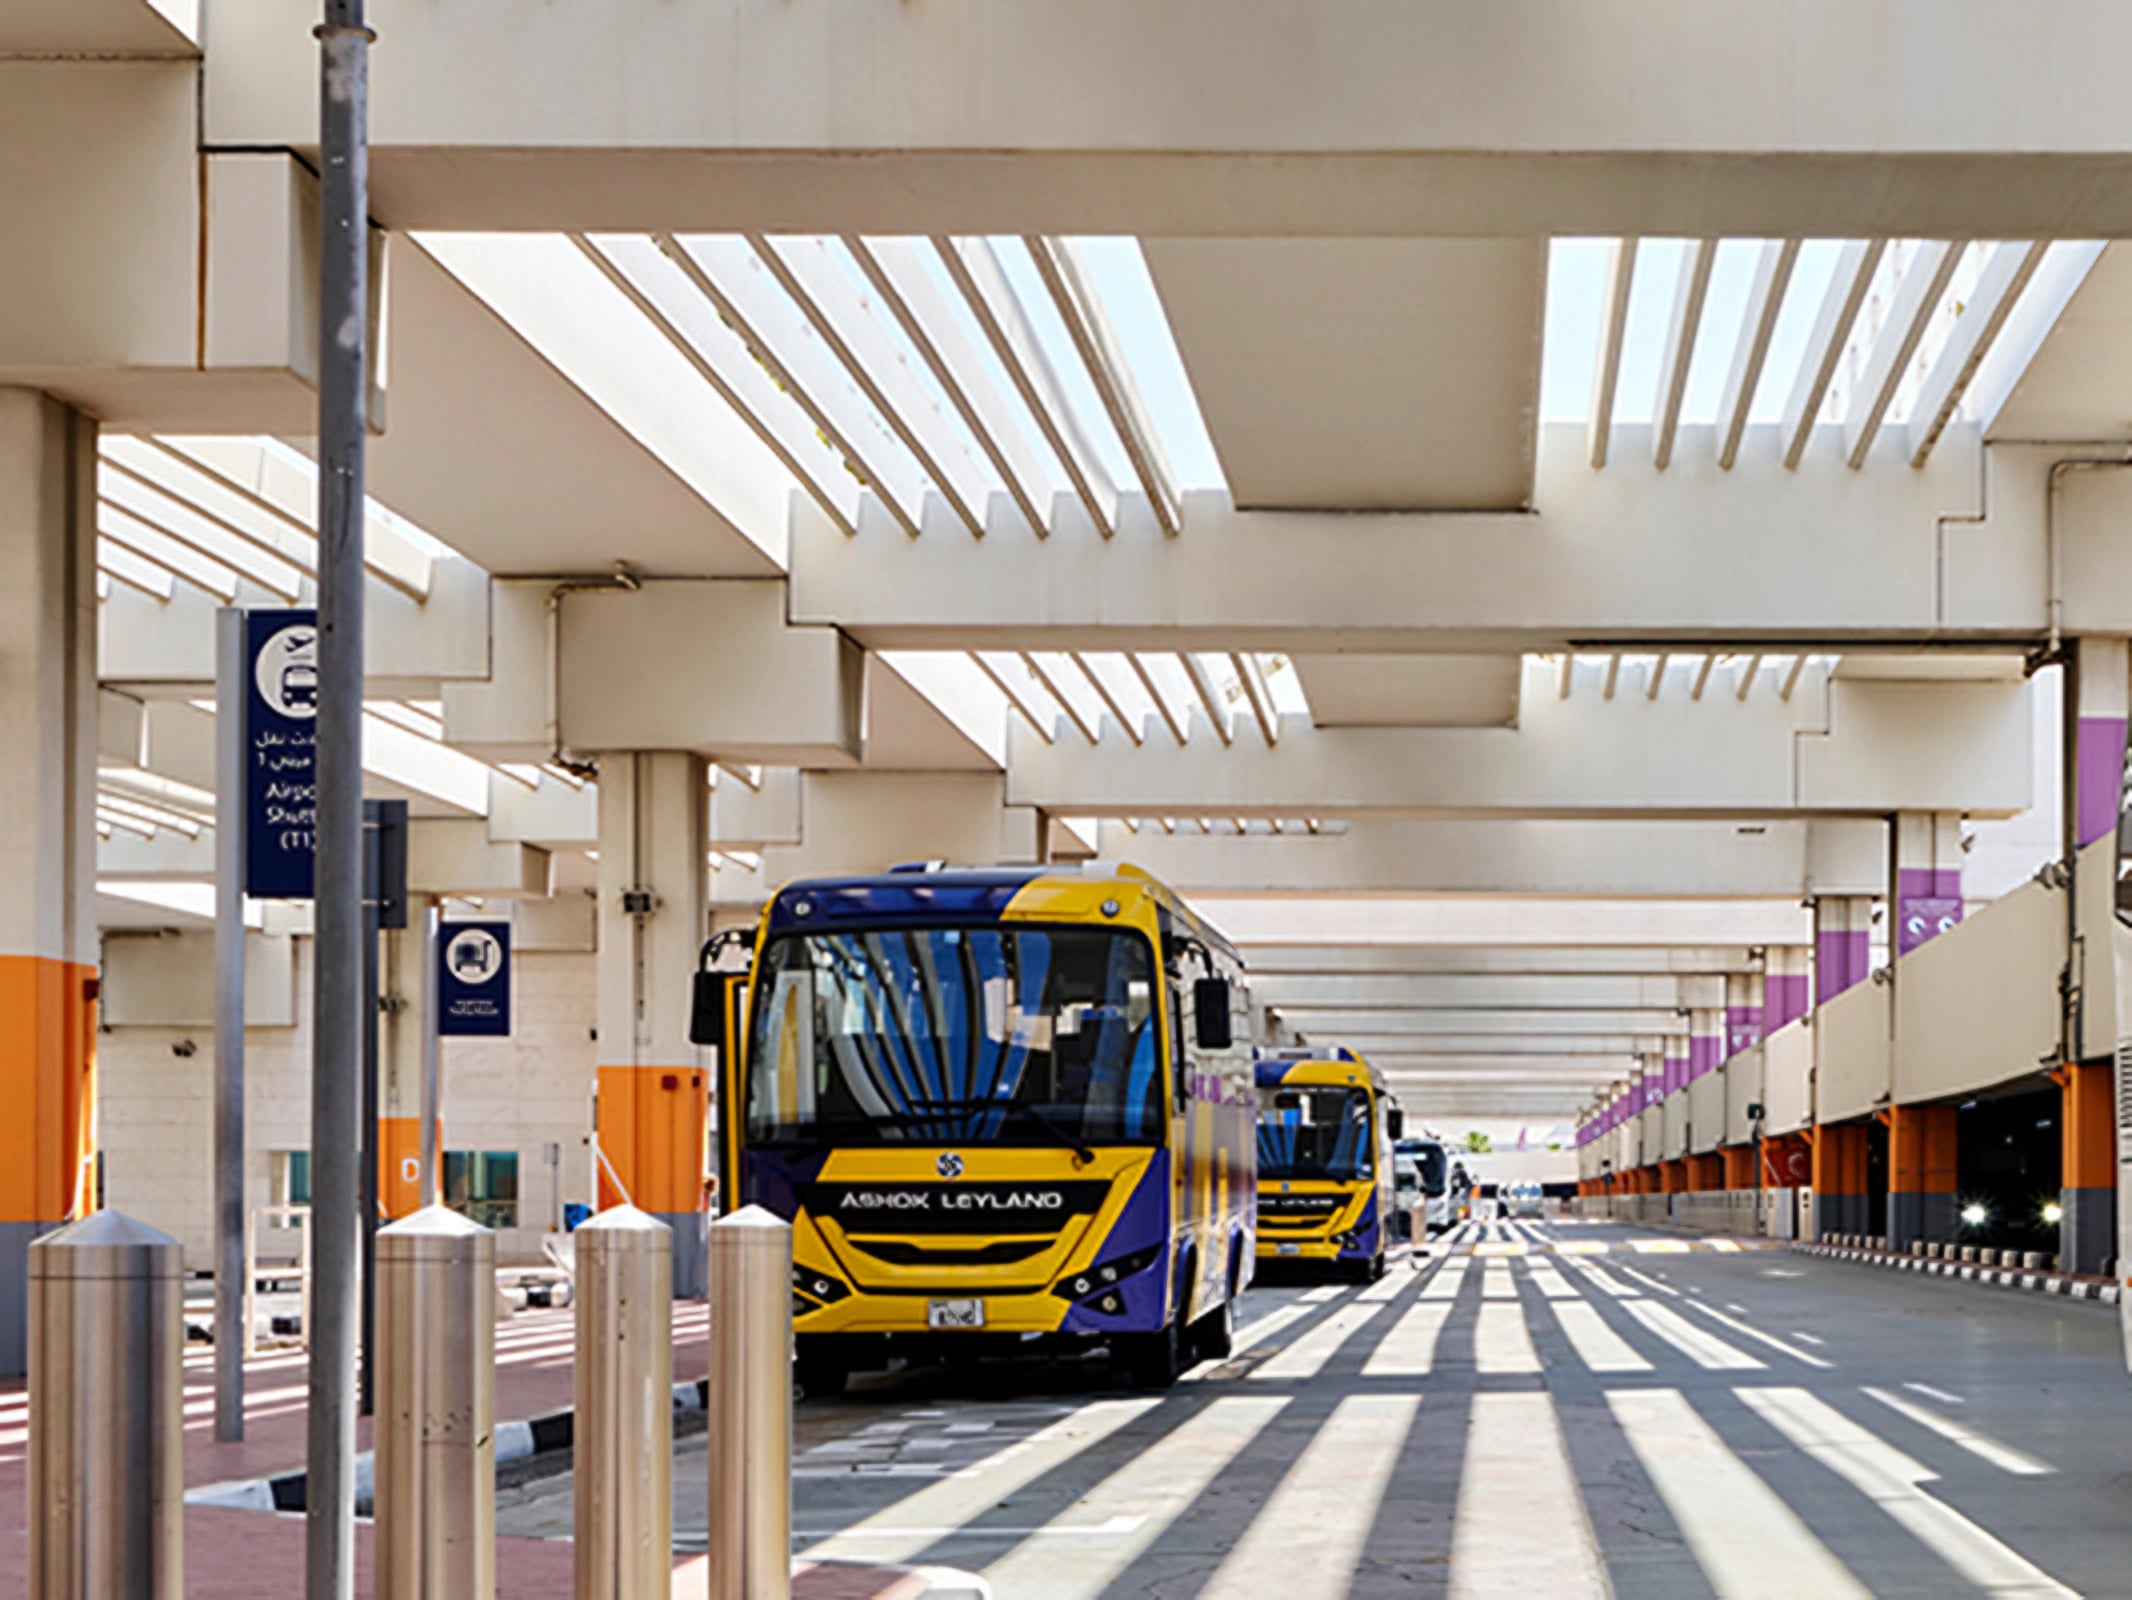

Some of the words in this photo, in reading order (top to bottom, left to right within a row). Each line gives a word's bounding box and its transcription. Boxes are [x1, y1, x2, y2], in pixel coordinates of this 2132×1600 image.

[266, 783, 316, 801] Airpo
[840, 1193, 929, 1208] ASHOK
[942, 1193, 1062, 1208] LEYLAND
